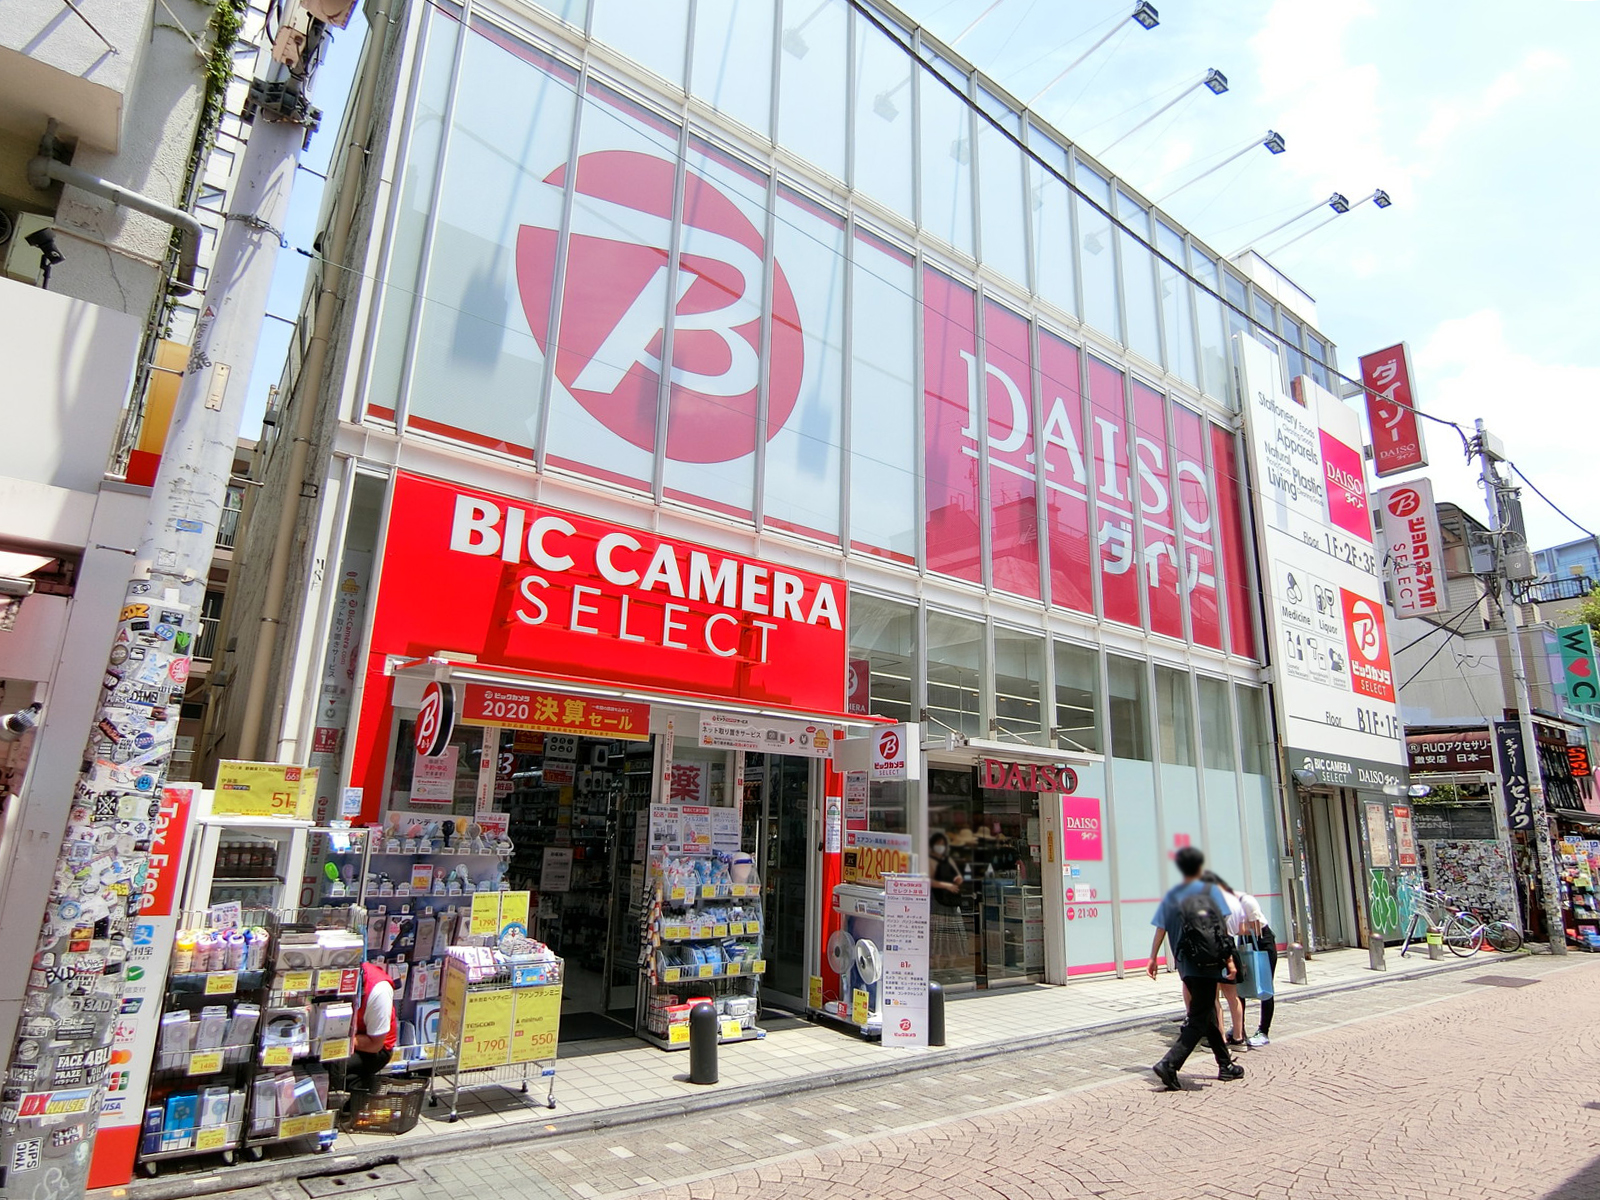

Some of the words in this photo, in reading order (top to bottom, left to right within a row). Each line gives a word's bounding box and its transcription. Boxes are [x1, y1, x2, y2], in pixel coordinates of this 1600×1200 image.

[1257, 391, 1298, 430] Stationery
[1373, 358, 1404, 442] ダイソー
[960, 349, 1212, 534] DAISO
[1277, 428, 1319, 466] Apparels
[1380, 443, 1416, 459] DAISO
[1264, 441, 1291, 467] Natural
[1267, 466, 1298, 502] Living
[1292, 466, 1323, 498] Plastic
[1325, 460, 1363, 495] DAISO
[1303, 531, 1320, 550] Floor
[450, 494, 578, 572] BIC
[594, 532, 843, 631] CAMERA
[1393, 543, 1416, 610] SELECT
[515, 575, 779, 664] SELECT
[1281, 606, 1312, 626] Medicine
[1318, 619, 1339, 635] Liquor
[1351, 659, 1391, 686] ビックカメラ
[494, 692, 531, 703] ビックカメラ
[1360, 679, 1387, 696] SELECT
[482, 700, 530, 720] 2020
[1325, 711, 1342, 727] Floor
[874, 760, 905, 770] ビックカメラ
[1314, 758, 1325, 771] BIC
[1325, 760, 1352, 774] CAMERA
[1414, 755, 1448, 764] 激安店
[1456, 753, 1491, 763] 日本一
[670, 764, 701, 802] 薬
[983, 758, 1078, 795] DAISO
[1322, 771, 1347, 784] SELECT
[1358, 769, 1384, 785] DAISO
[1506, 775, 1530, 829] ハセガワ
[155, 801, 179, 847] Tax
[1066, 816, 1098, 829] DAISO
[858, 846, 900, 880] 42,800
[142, 853, 170, 909] Free
[1077, 907, 1098, 919] 21:00
[131, 946, 154, 957] 付宝
[531, 1032, 554, 1047] 550
[57, 1055, 84, 1068] FACE
[18, 1093, 53, 1117] DX
[101, 1102, 121, 1111] VISA
